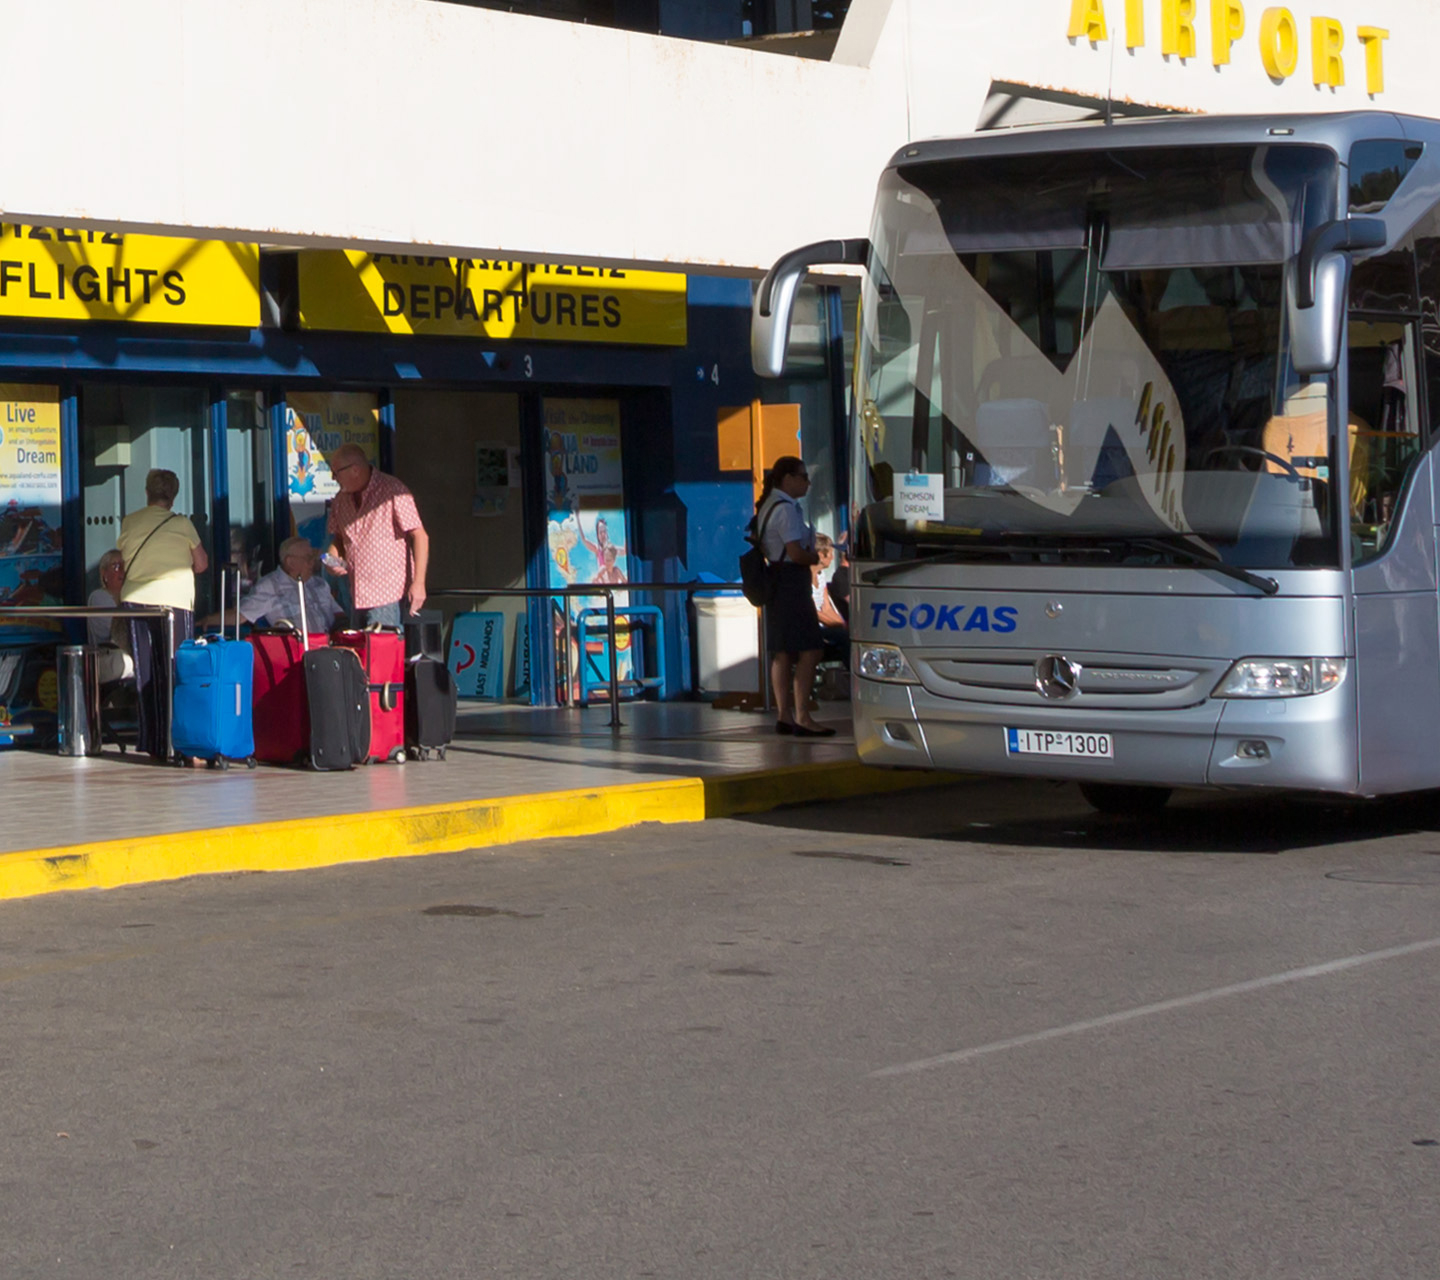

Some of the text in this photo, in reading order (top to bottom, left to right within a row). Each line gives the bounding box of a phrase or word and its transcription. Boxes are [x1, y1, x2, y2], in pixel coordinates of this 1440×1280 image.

[0, 259, 187, 306] FLIGHTS
[383, 282, 622, 328] DEPARTURES
[523, 355, 533, 378] 3
[711, 363, 719, 386] 4
[7, 403, 36, 423] Live
[326, 407, 350, 425] Live
[344, 430, 376, 443] Dream
[17, 448, 57, 464] Dream
[899, 491, 935, 501] THOMSON
[904, 504, 929, 513] DREAM
[870, 602, 1018, 633] TSOKAS
[475, 619, 494, 695] EAST MIDLANDS
